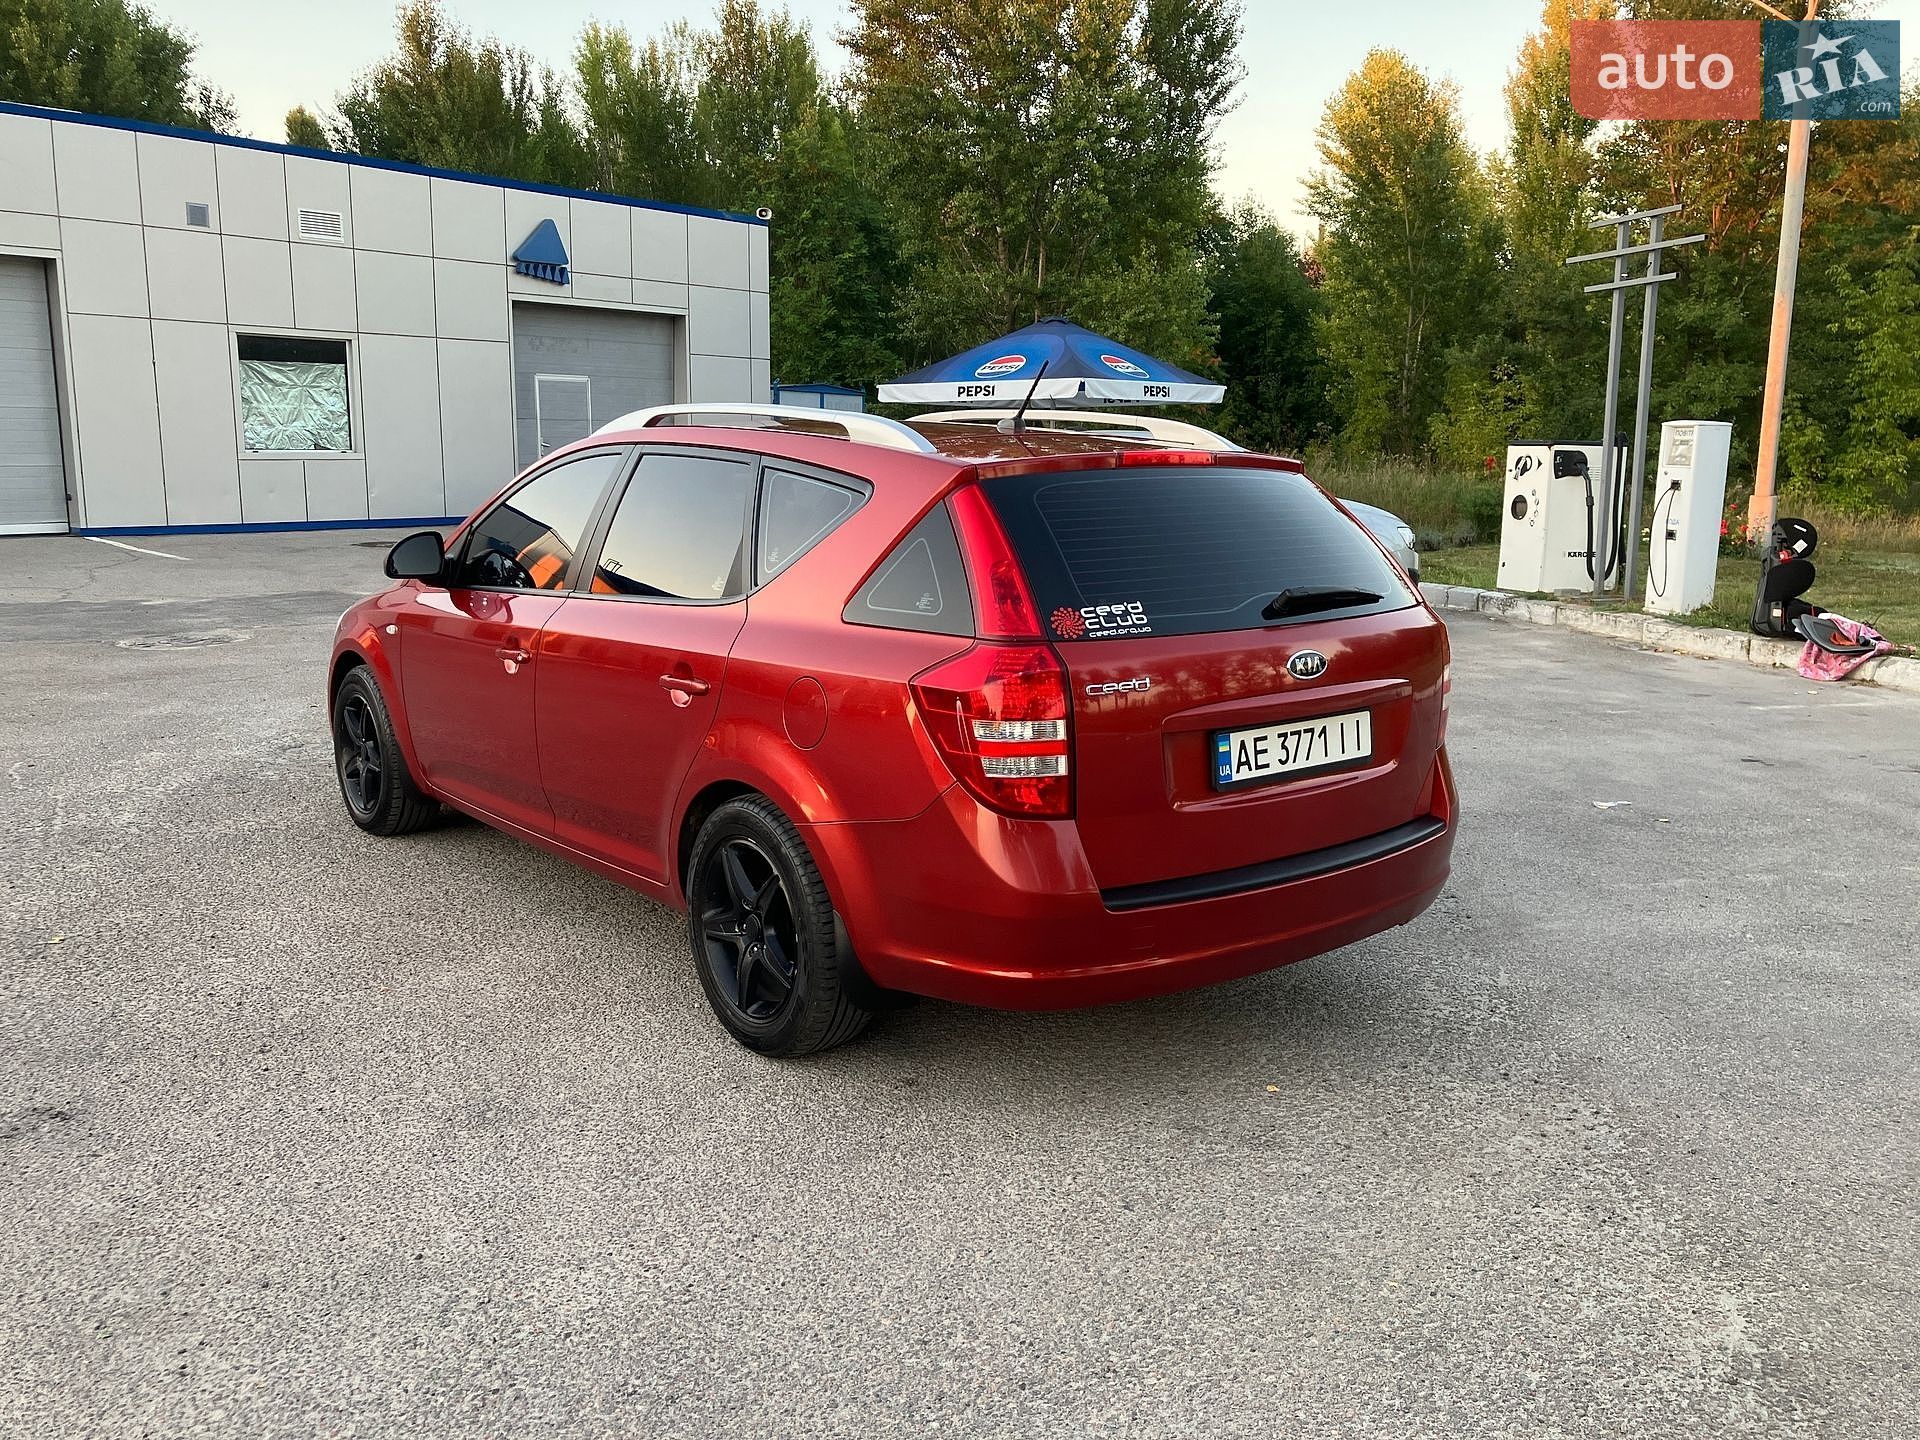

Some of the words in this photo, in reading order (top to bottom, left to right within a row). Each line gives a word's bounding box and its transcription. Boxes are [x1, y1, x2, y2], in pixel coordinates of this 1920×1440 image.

[957, 384, 996, 398] PEPSI
[1143, 385, 1170, 398] PEPSI
[1295, 655, 1323, 673] KIA
[1235, 735, 1270, 774] AE
[1277, 725, 1329, 766] 3771
[1219, 764, 1231, 776] UA
